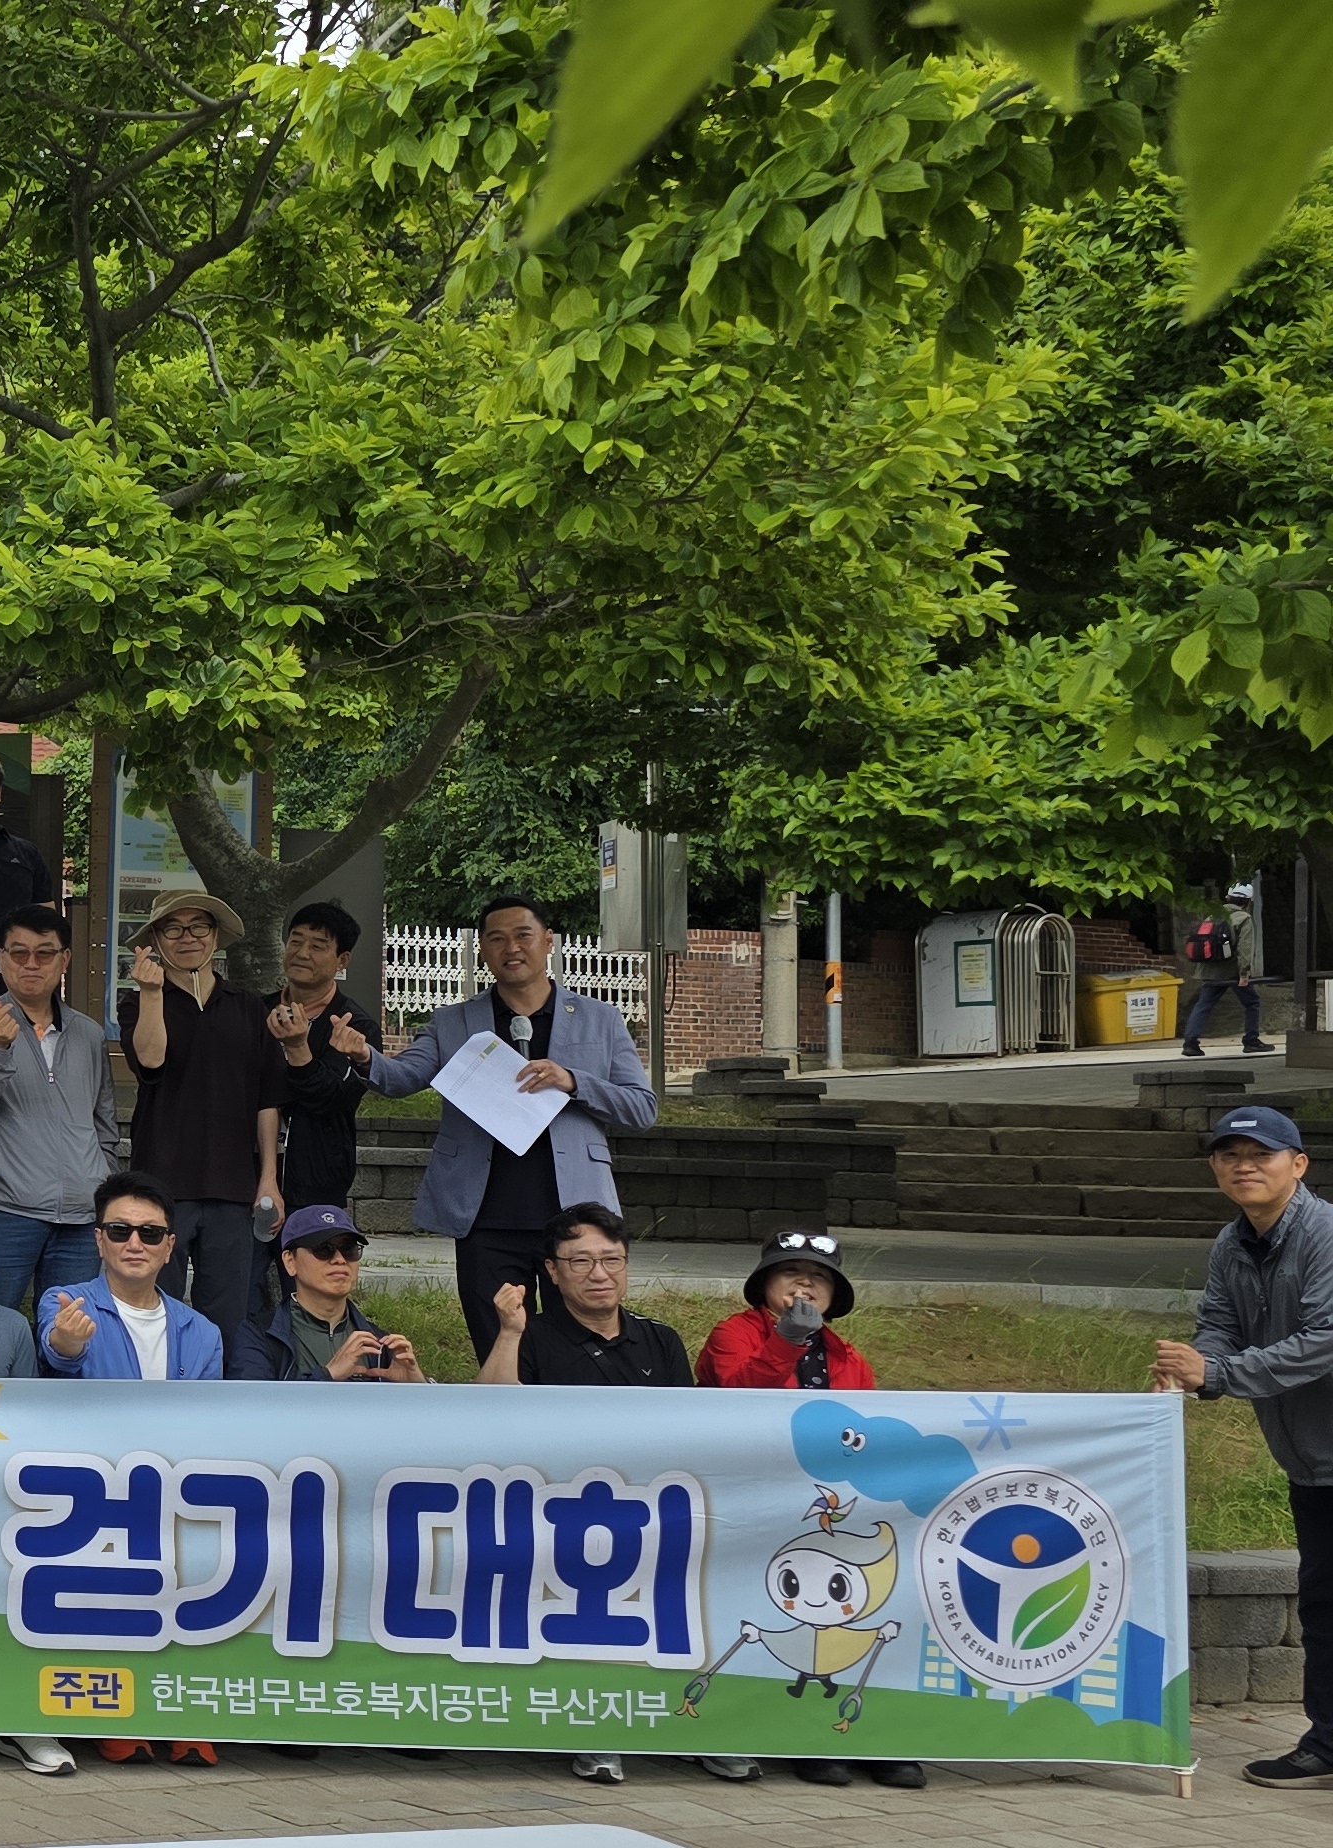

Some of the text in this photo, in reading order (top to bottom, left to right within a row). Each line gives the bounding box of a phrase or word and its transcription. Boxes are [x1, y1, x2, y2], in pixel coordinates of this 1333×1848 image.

[936, 1482, 1107, 1549] 한국법무보호복지공단
[15, 1464, 325, 1643] 걷기
[383, 1478, 692, 1655] 대회
[938, 1580, 1110, 1670] KOREA REHABILITATION AGENCY
[50, 1672, 671, 1728] 주관 한국법무보호복지공단 부산지부
